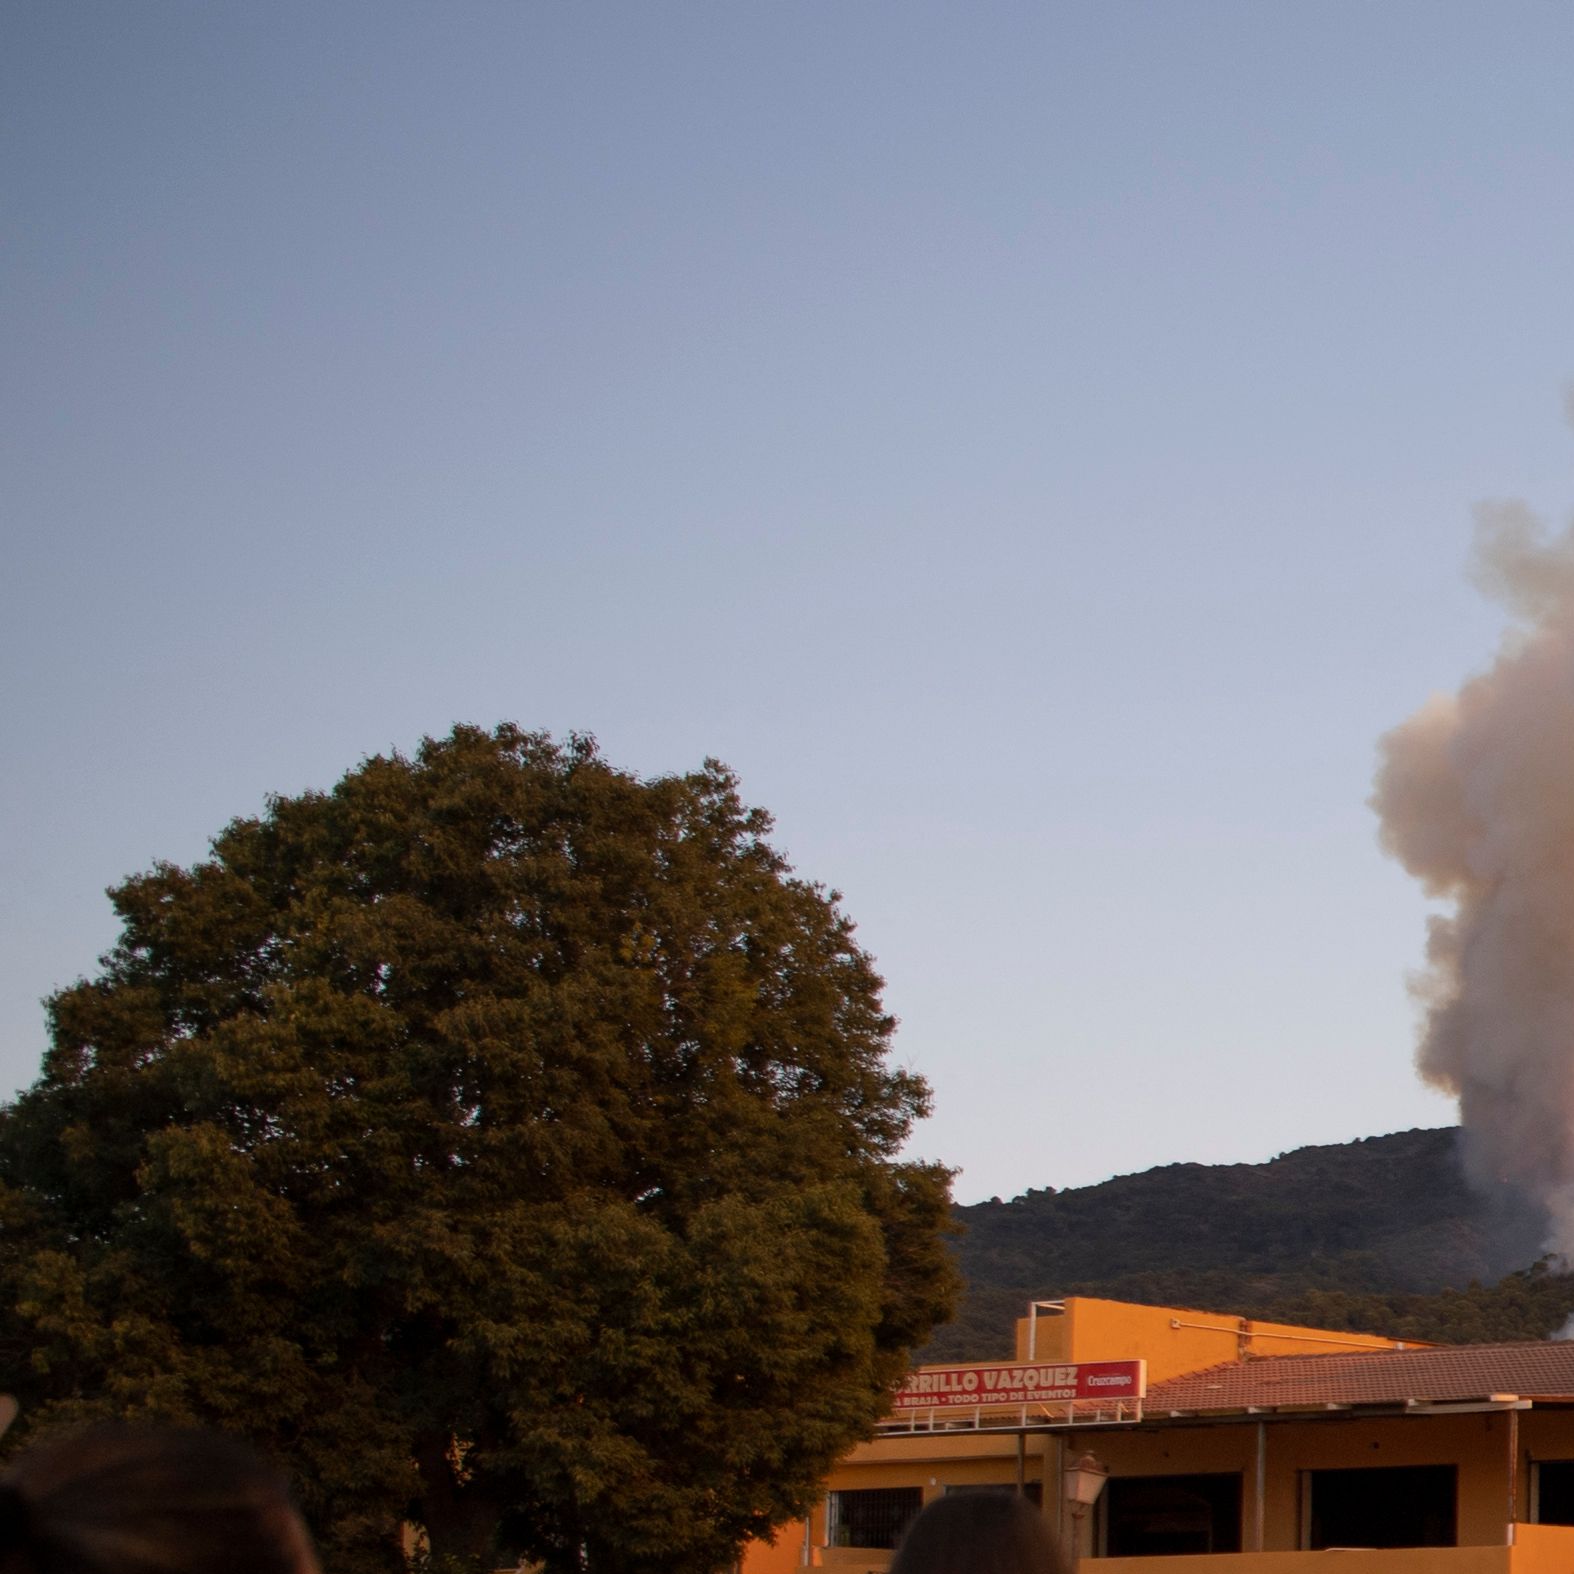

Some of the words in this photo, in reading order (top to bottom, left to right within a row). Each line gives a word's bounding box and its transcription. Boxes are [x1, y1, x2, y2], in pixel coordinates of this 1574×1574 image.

[901, 1371, 979, 1394] RRILLO
[983, 1366, 1078, 1391] VAZQUEZ
[947, 1393, 979, 1404] TODO
[982, 1391, 1007, 1403] TIPO
[1009, 1391, 1025, 1402] DE
[1026, 1388, 1076, 1401] EVENTOS
